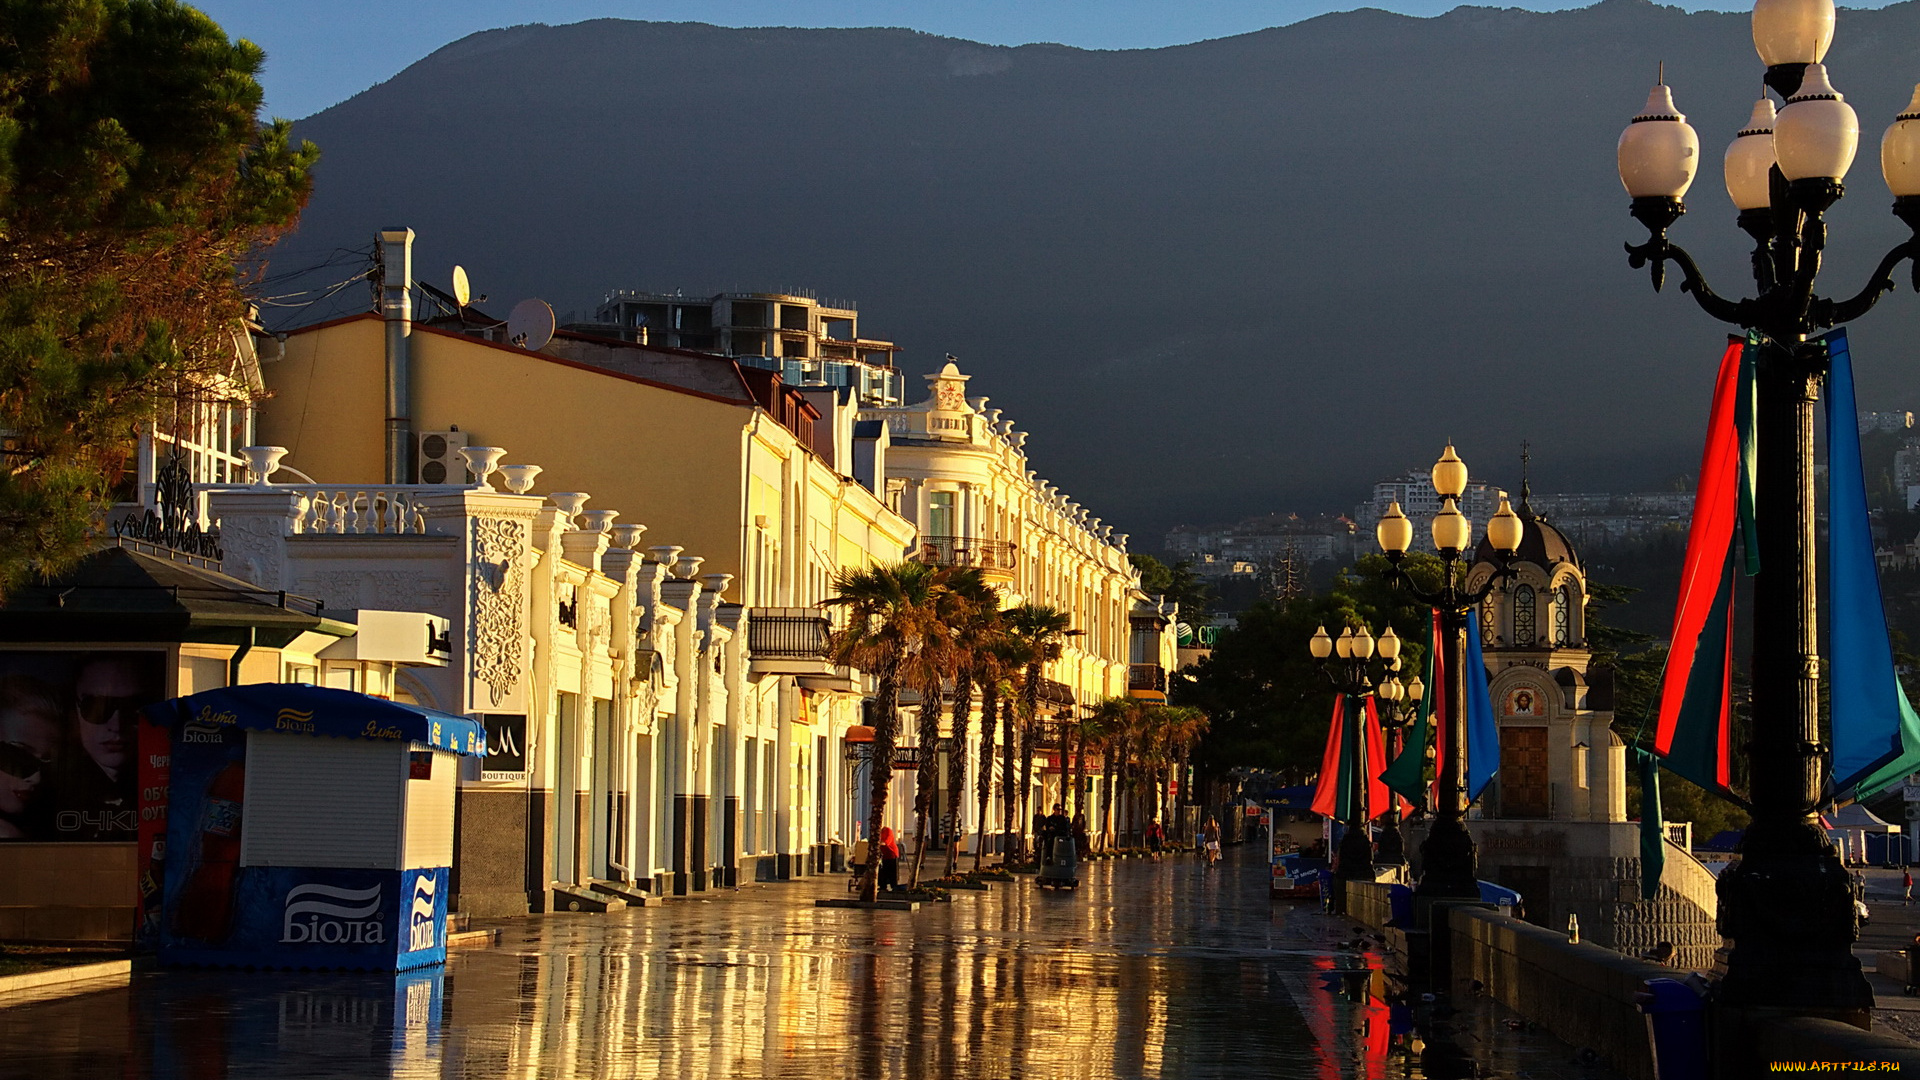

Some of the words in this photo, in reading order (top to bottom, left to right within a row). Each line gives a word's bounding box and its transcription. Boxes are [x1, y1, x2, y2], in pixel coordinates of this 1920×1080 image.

[1198, 625, 1219, 645] СБ
[196, 704, 238, 725] Ялта
[275, 714, 315, 733] Біола
[182, 724, 223, 743] Біола
[361, 719, 403, 740] Ялта
[481, 772, 526, 781] BOUTIQUE
[142, 805, 168, 821] ФУТ
[278, 900, 387, 944] Біола
[409, 897, 434, 952] Біола
